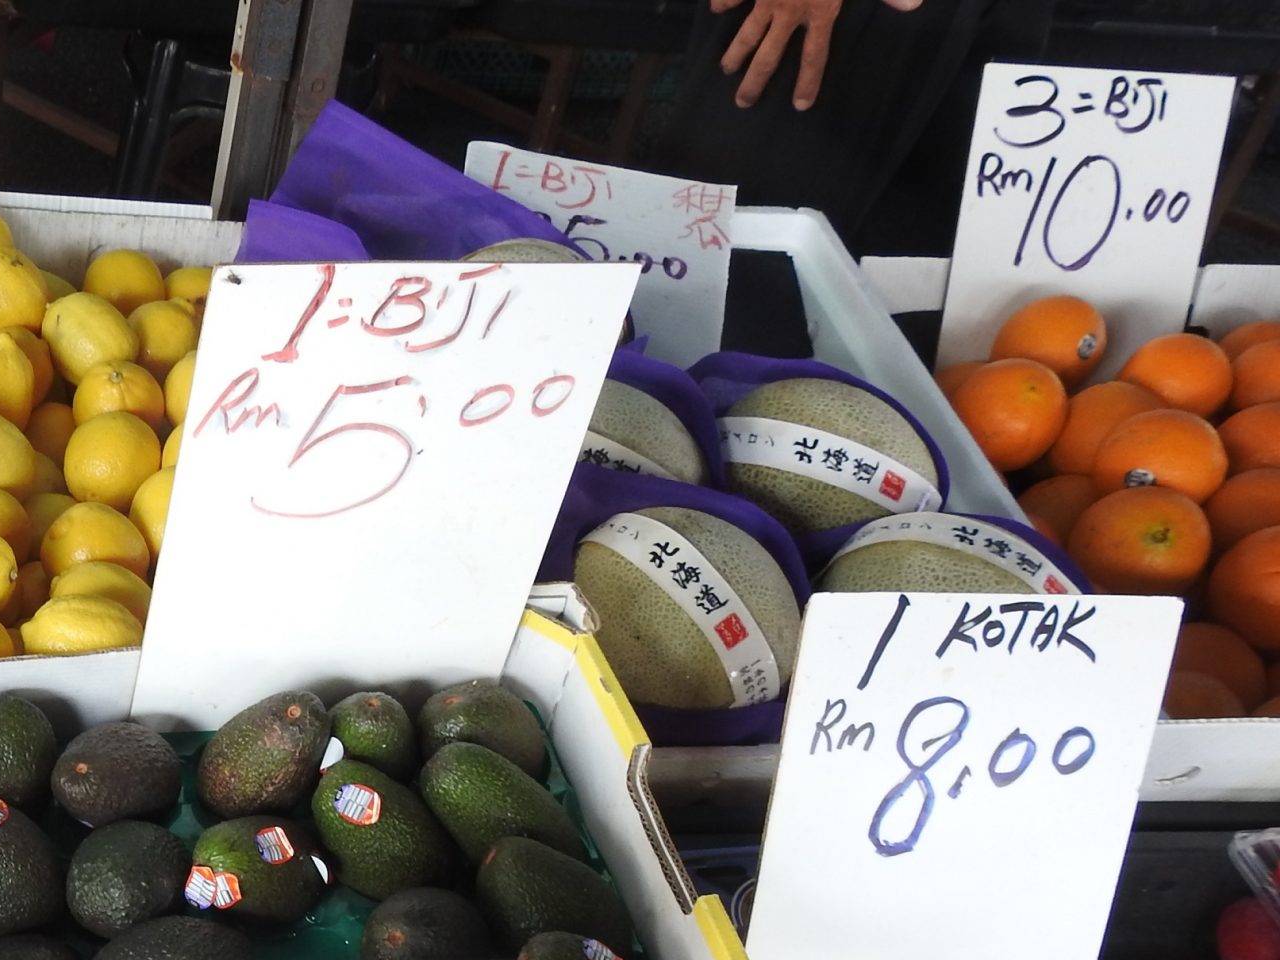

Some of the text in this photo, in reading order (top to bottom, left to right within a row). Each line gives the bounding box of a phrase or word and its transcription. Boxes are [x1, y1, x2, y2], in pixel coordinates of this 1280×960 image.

[1013, 155, 1190, 271] 10.00
[793, 437, 881, 484] 北海道
[649, 541, 730, 615] 北海道
[858, 595, 910, 690] 1
